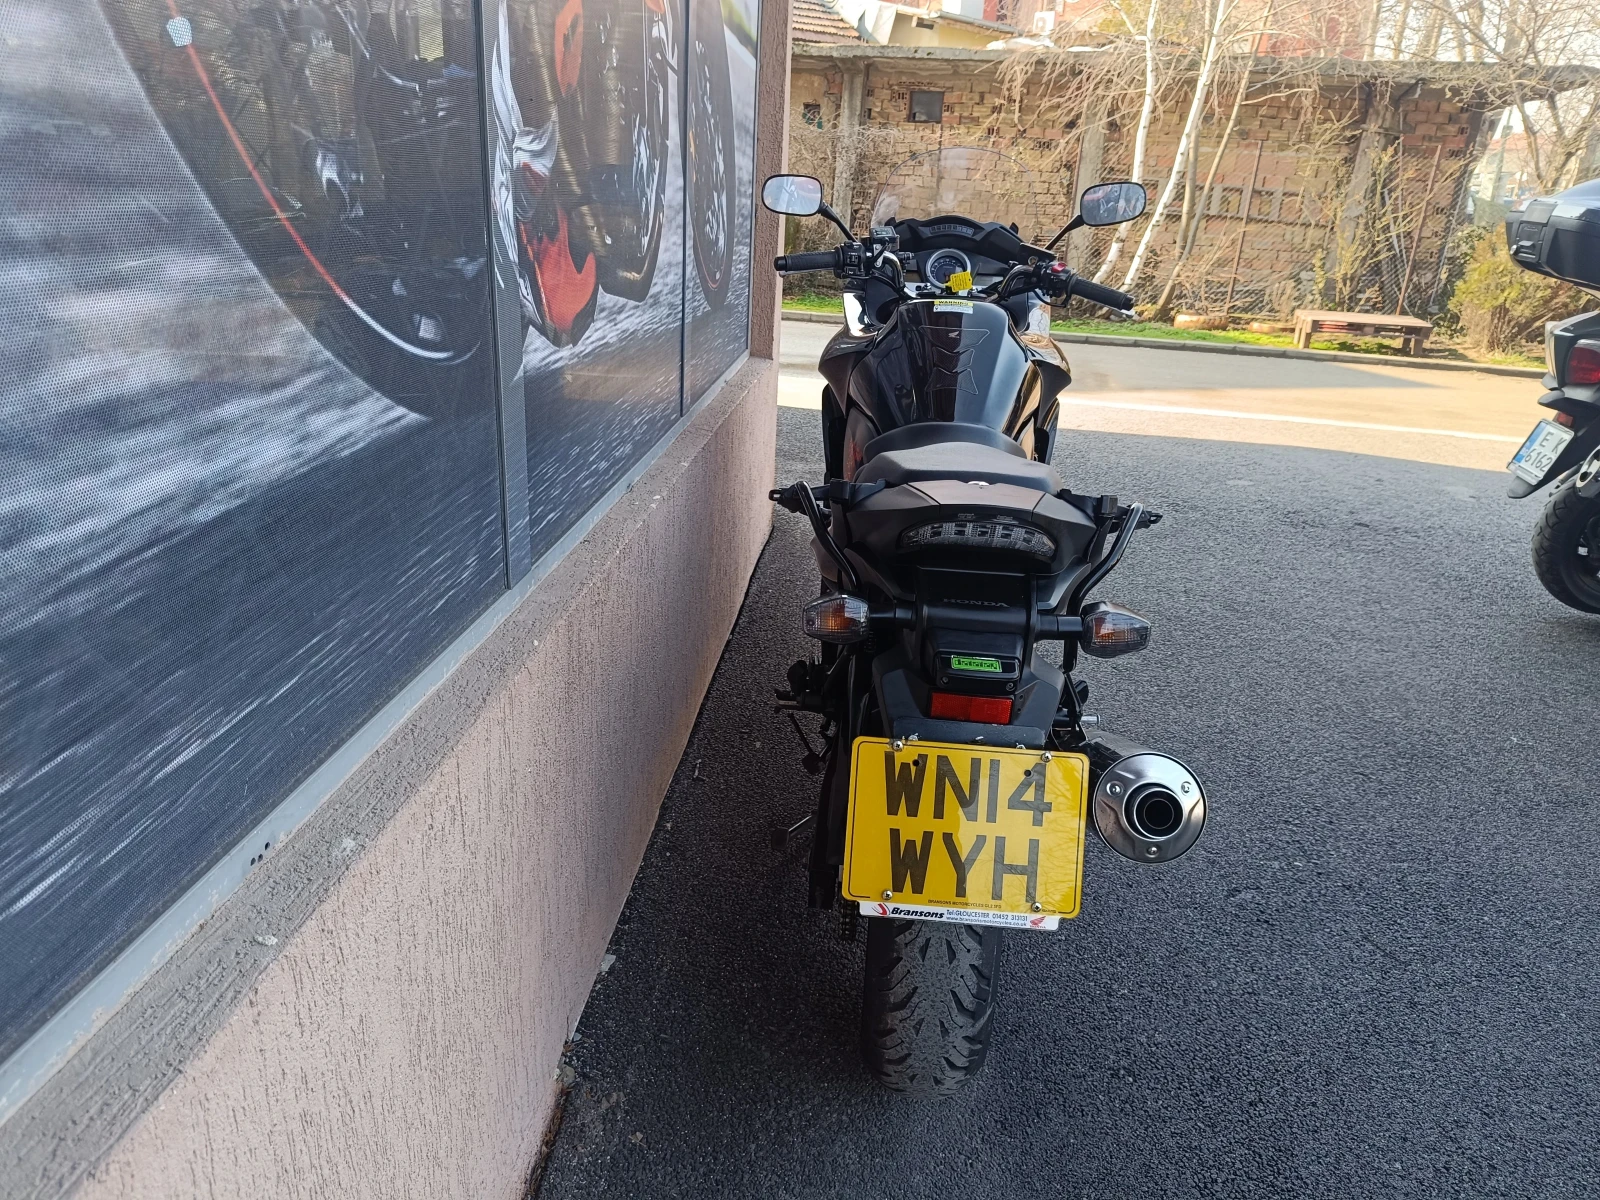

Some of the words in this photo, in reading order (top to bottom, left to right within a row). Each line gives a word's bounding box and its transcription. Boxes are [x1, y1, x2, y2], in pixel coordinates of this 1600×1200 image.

[1539, 431, 1555, 448] E
[1551, 437, 1568, 454] K
[1524, 448, 1553, 473] 6162
[943, 598, 1010, 608] HONDA
[884, 750, 1053, 827] WN14
[889, 827, 1040, 903] WYH
[891, 906, 945, 919] Bransons
[992, 913, 1009, 921] 01452
